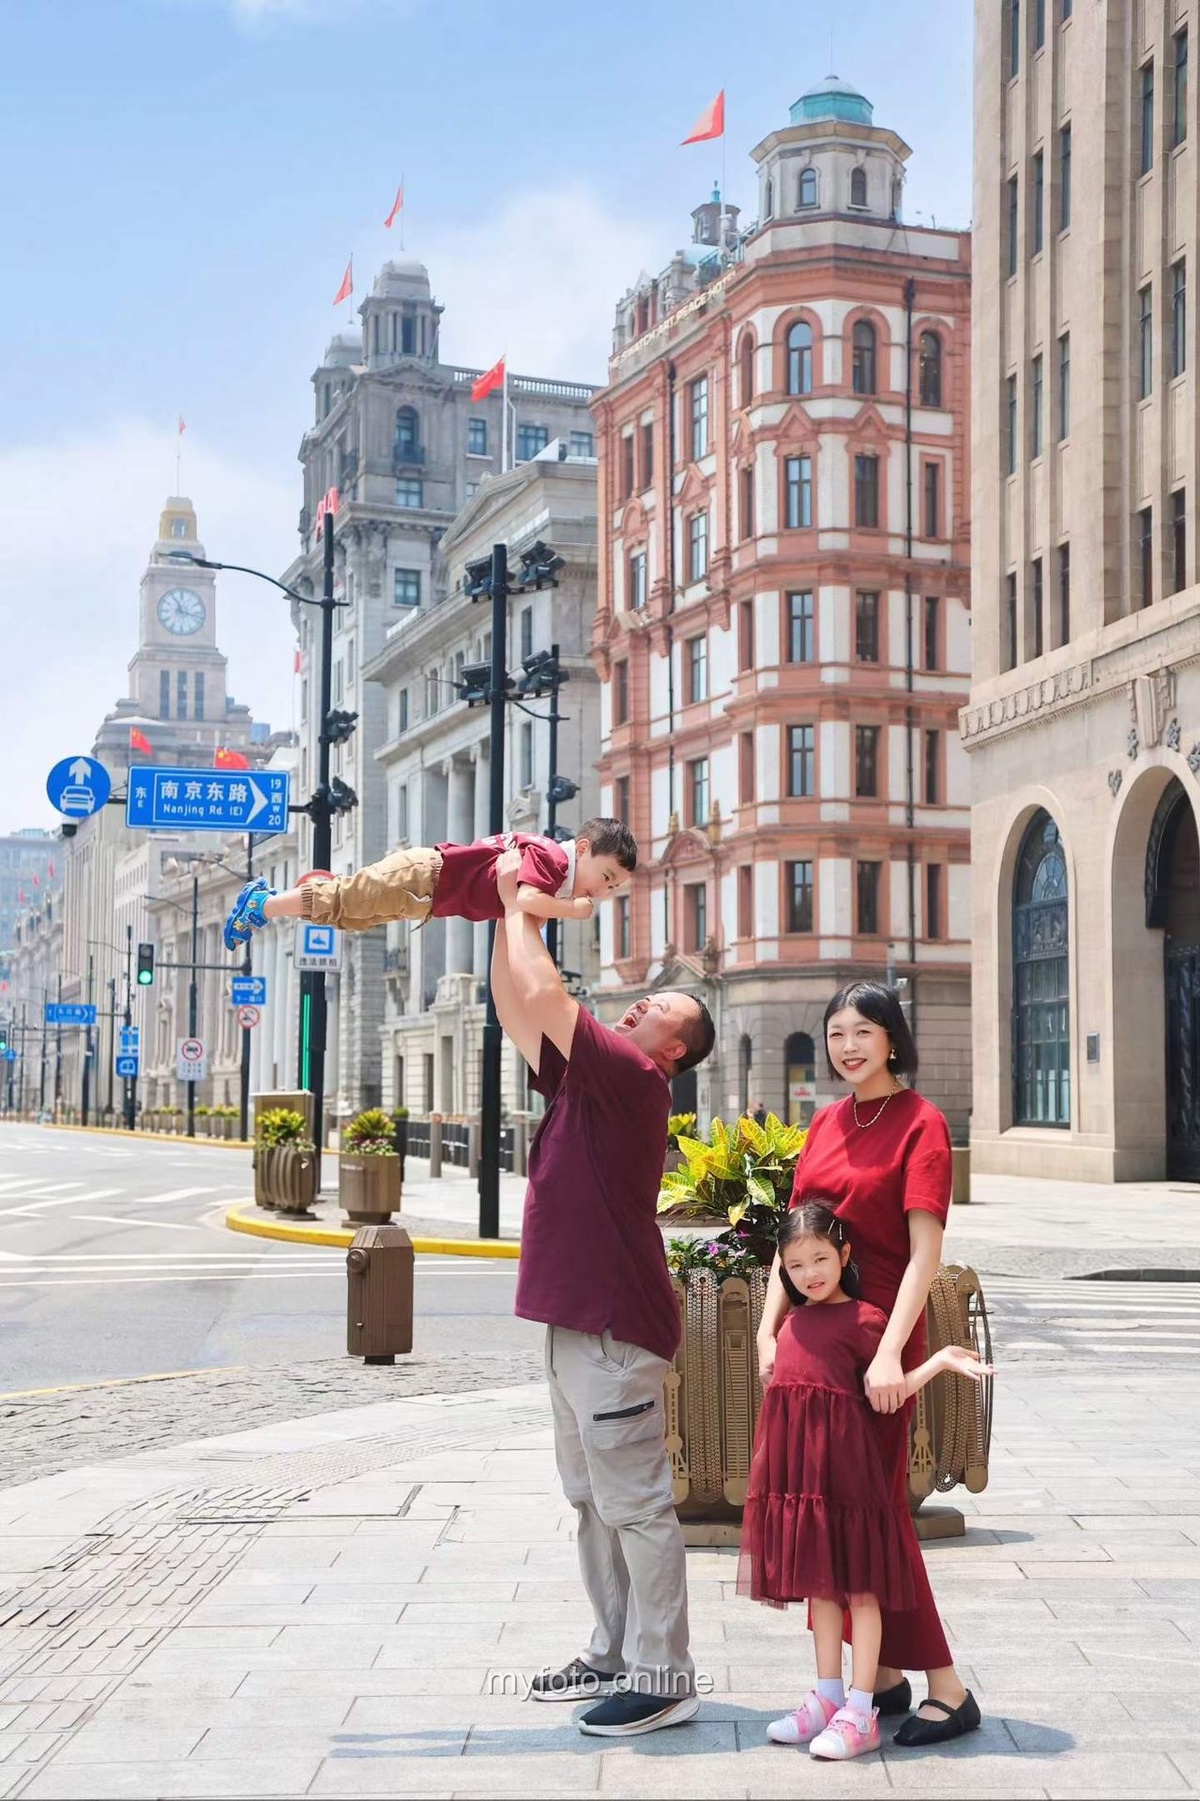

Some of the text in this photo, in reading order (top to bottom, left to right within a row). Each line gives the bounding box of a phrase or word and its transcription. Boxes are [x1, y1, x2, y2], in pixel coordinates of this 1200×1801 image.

[270, 778, 282, 790] 19
[136, 787, 147, 799] 东
[160, 780, 248, 803] 南京东路
[271, 792, 283, 804] 西
[163, 803, 204, 817] Nanjing
[229, 805, 243, 816] (E)
[272, 804, 281, 814] W
[268, 814, 281, 826] 20
